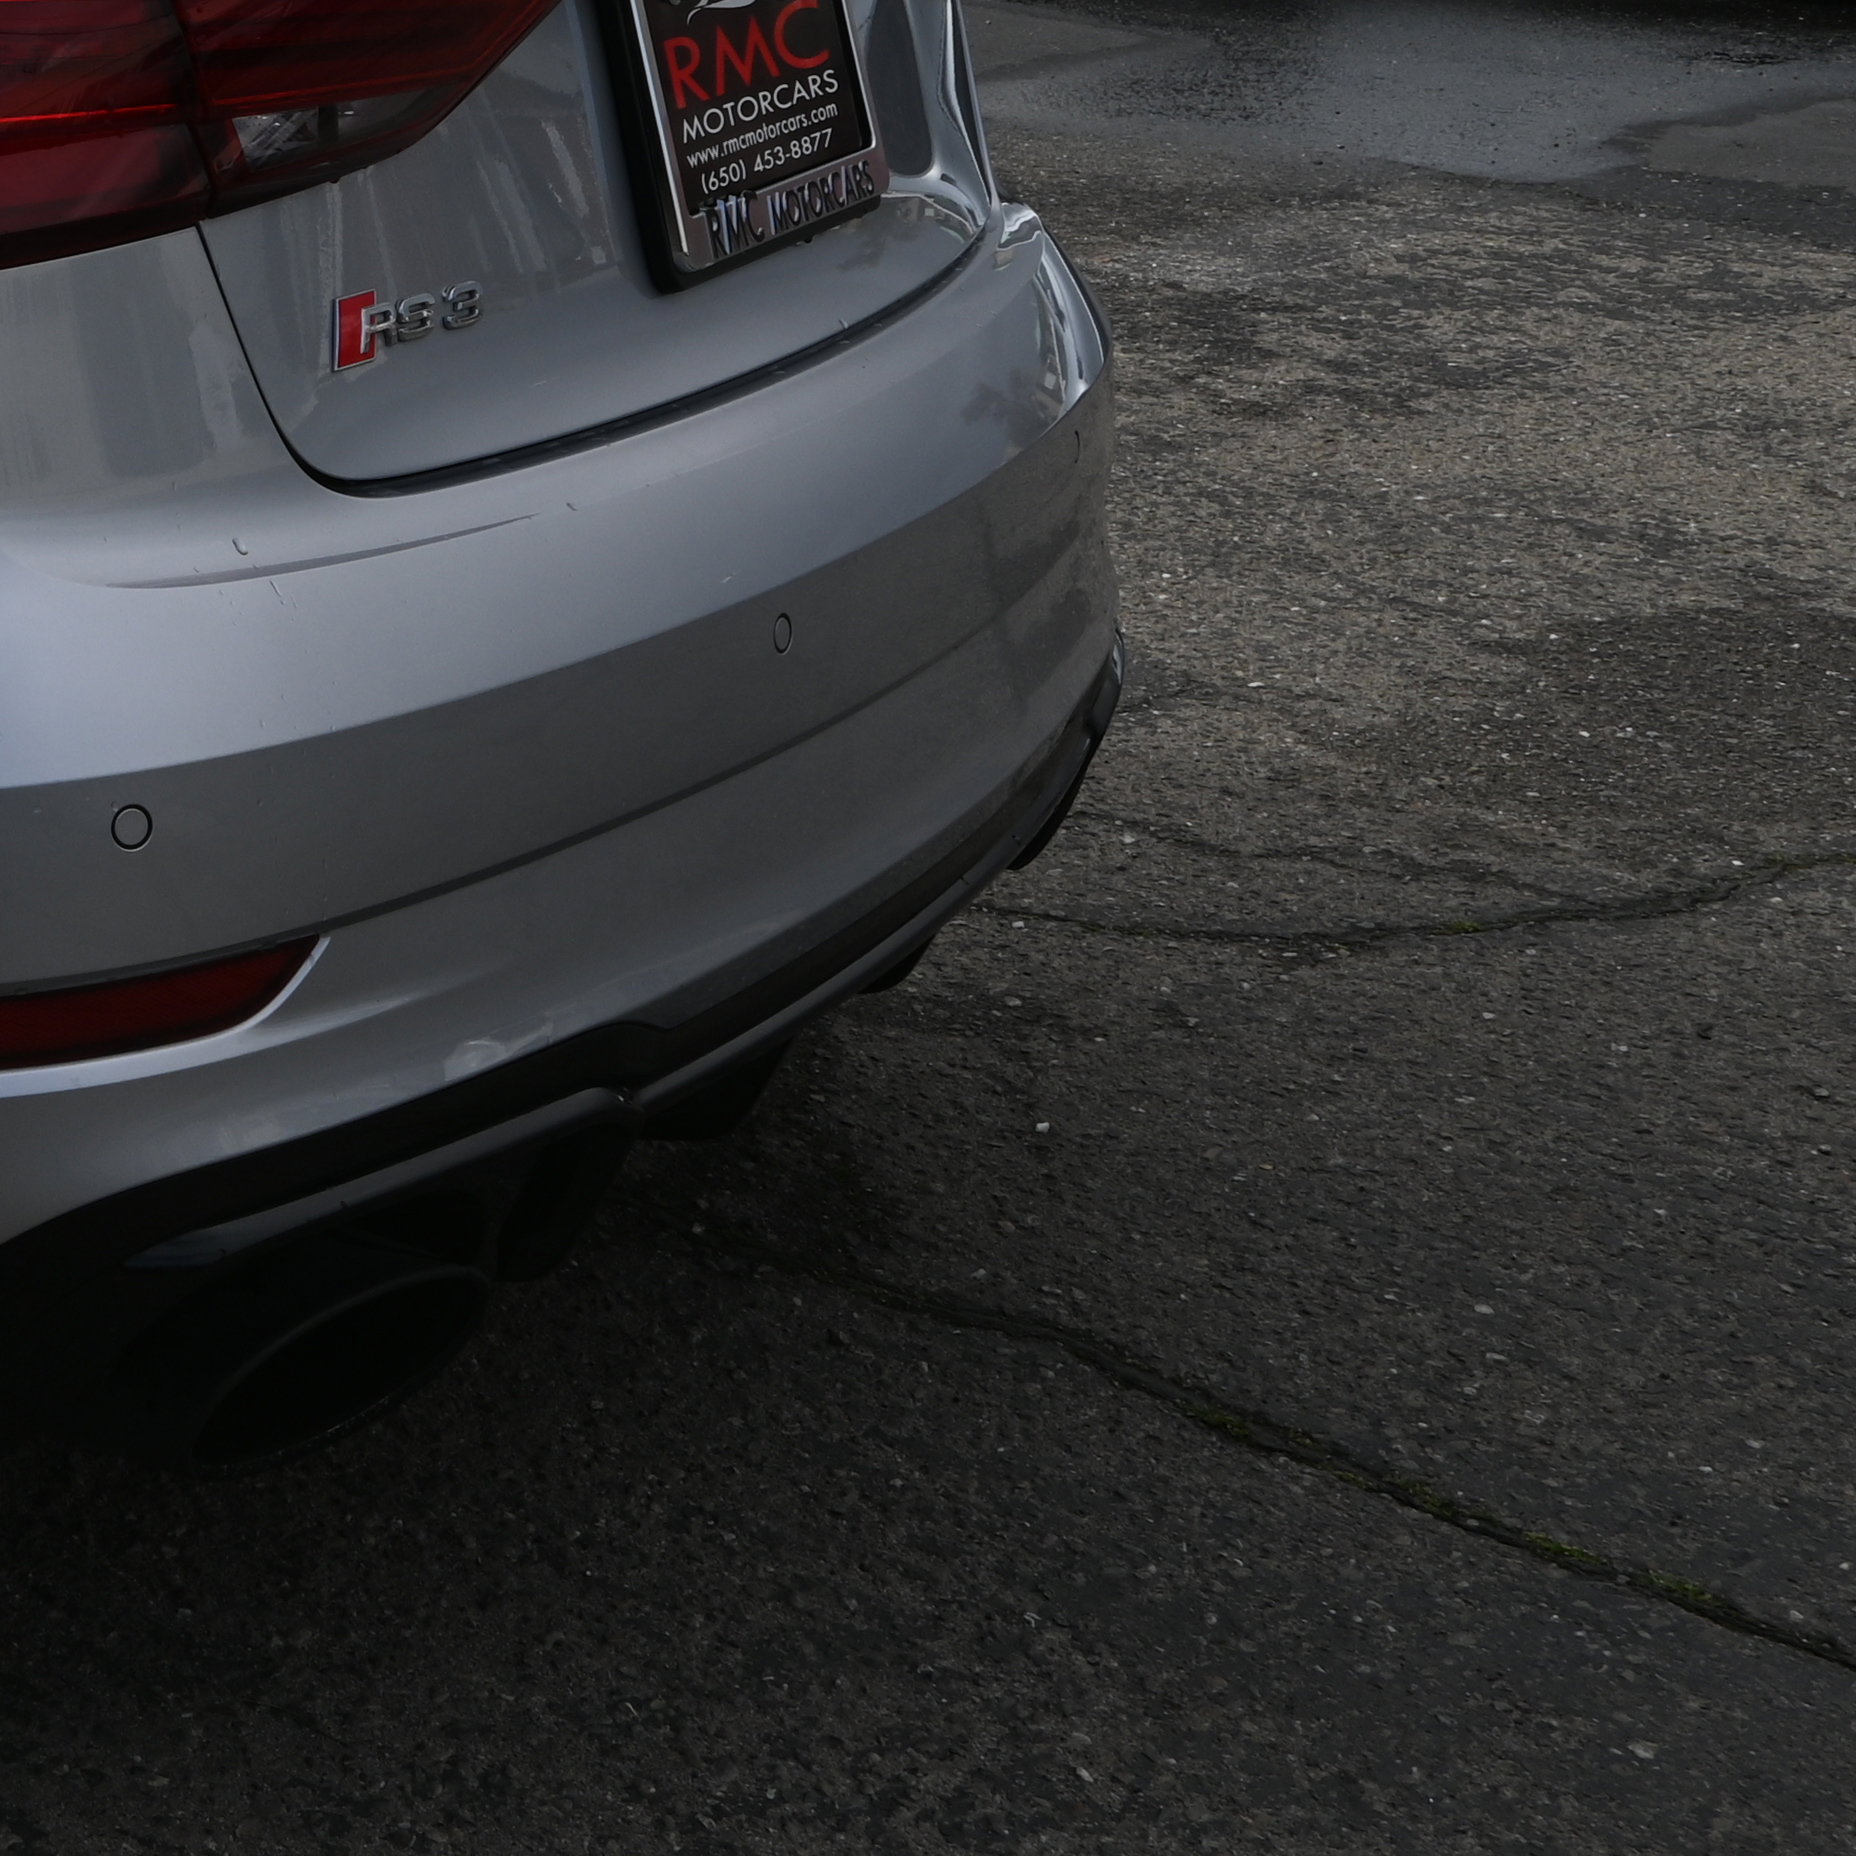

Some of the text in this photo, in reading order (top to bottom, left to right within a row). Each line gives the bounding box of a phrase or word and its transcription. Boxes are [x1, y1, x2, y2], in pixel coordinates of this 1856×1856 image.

[682, 69, 839, 143] MOTORCARS
[687, 103, 838, 168] www.rmcmotorcars.com
[701, 128, 833, 194] (650) 453-8877
[703, 160, 876, 258] RMC MOTORCARS
